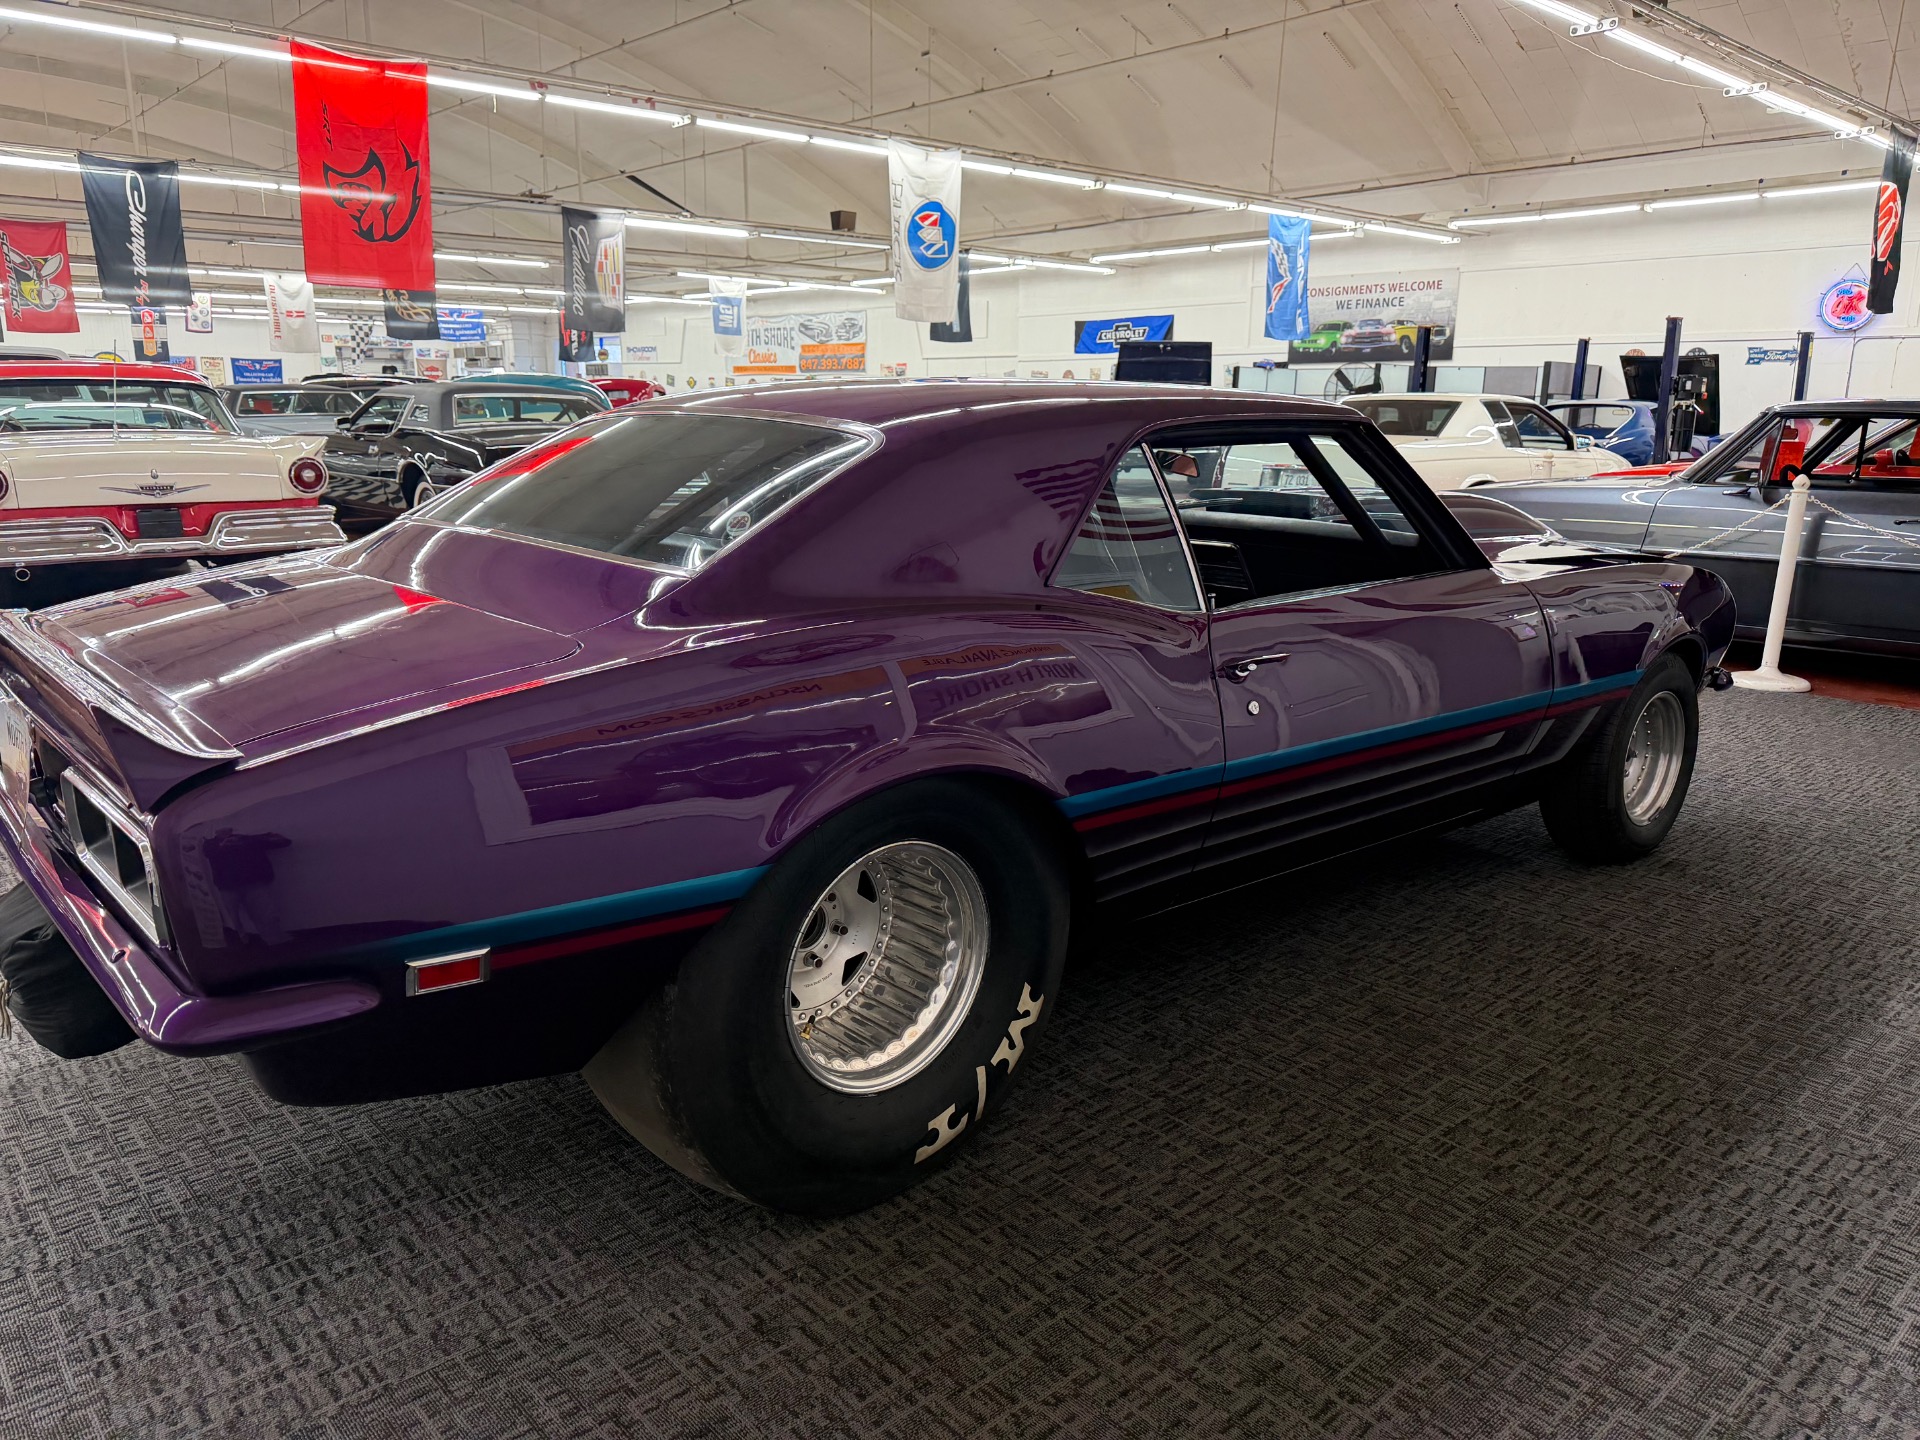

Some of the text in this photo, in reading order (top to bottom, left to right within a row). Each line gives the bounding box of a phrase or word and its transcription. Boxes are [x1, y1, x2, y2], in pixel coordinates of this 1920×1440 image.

[125, 170, 150, 306] Charger R/T
[0, 231, 23, 321] SCAT PACK
[568, 225, 591, 316] Cadillac
[1388, 279, 1443, 293] WELCOME
[269, 284, 282, 340] OLDSMOBILE
[1336, 296, 1405, 311] WE FINANCE
[763, 327, 795, 351] SHORE
[1101, 329, 1144, 340] CHEVROLET
[748, 348, 778, 364] Classics
[800, 357, 865, 371] 847.393.7887
[1764, 350, 1788, 360] Ford
[914, 981, 1044, 1165] M/T
